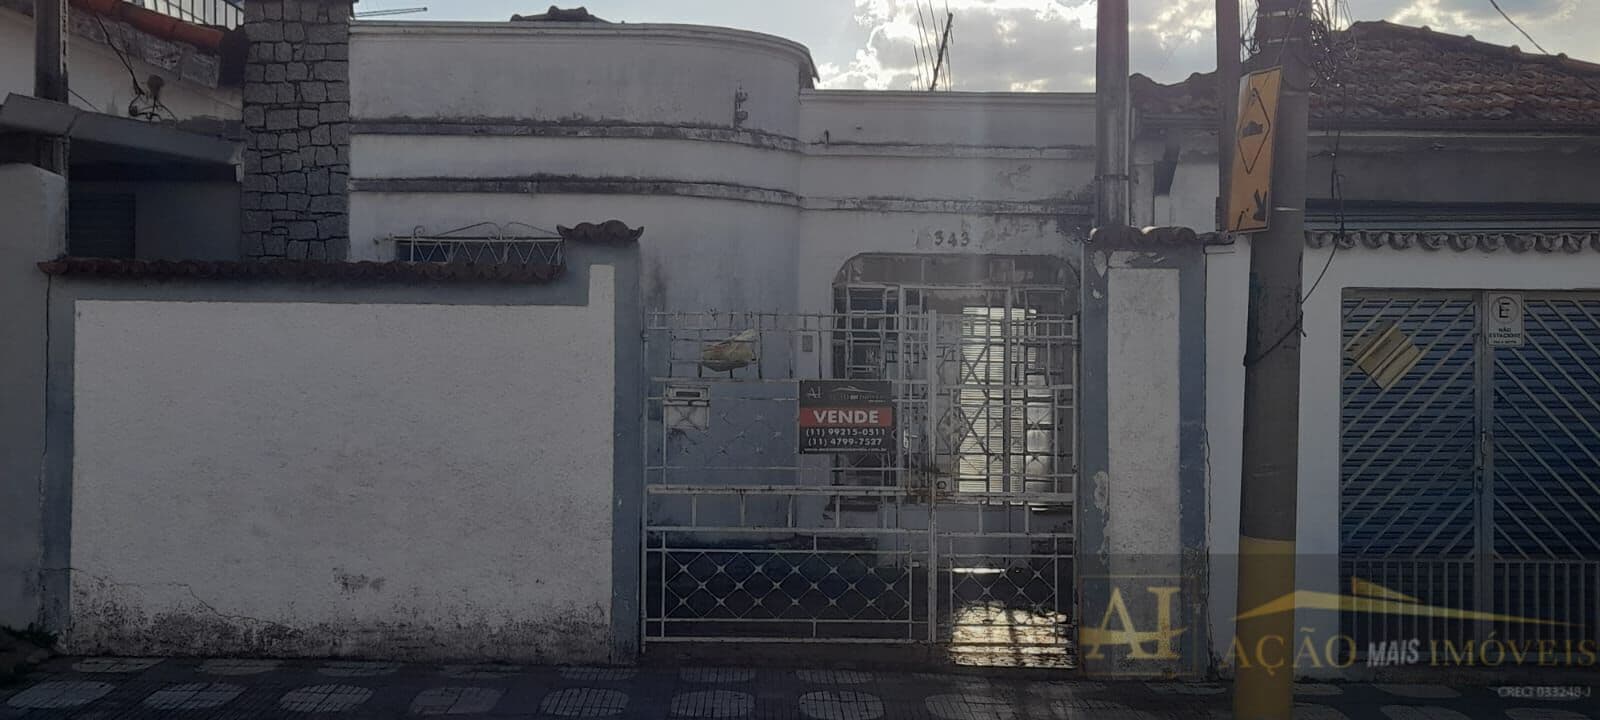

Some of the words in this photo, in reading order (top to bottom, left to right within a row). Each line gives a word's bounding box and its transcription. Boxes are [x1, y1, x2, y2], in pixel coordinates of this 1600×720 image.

[813, 409, 880, 424] VENDE
[806, 428, 826, 437] (11)
[808, 438, 828, 447] (11)
